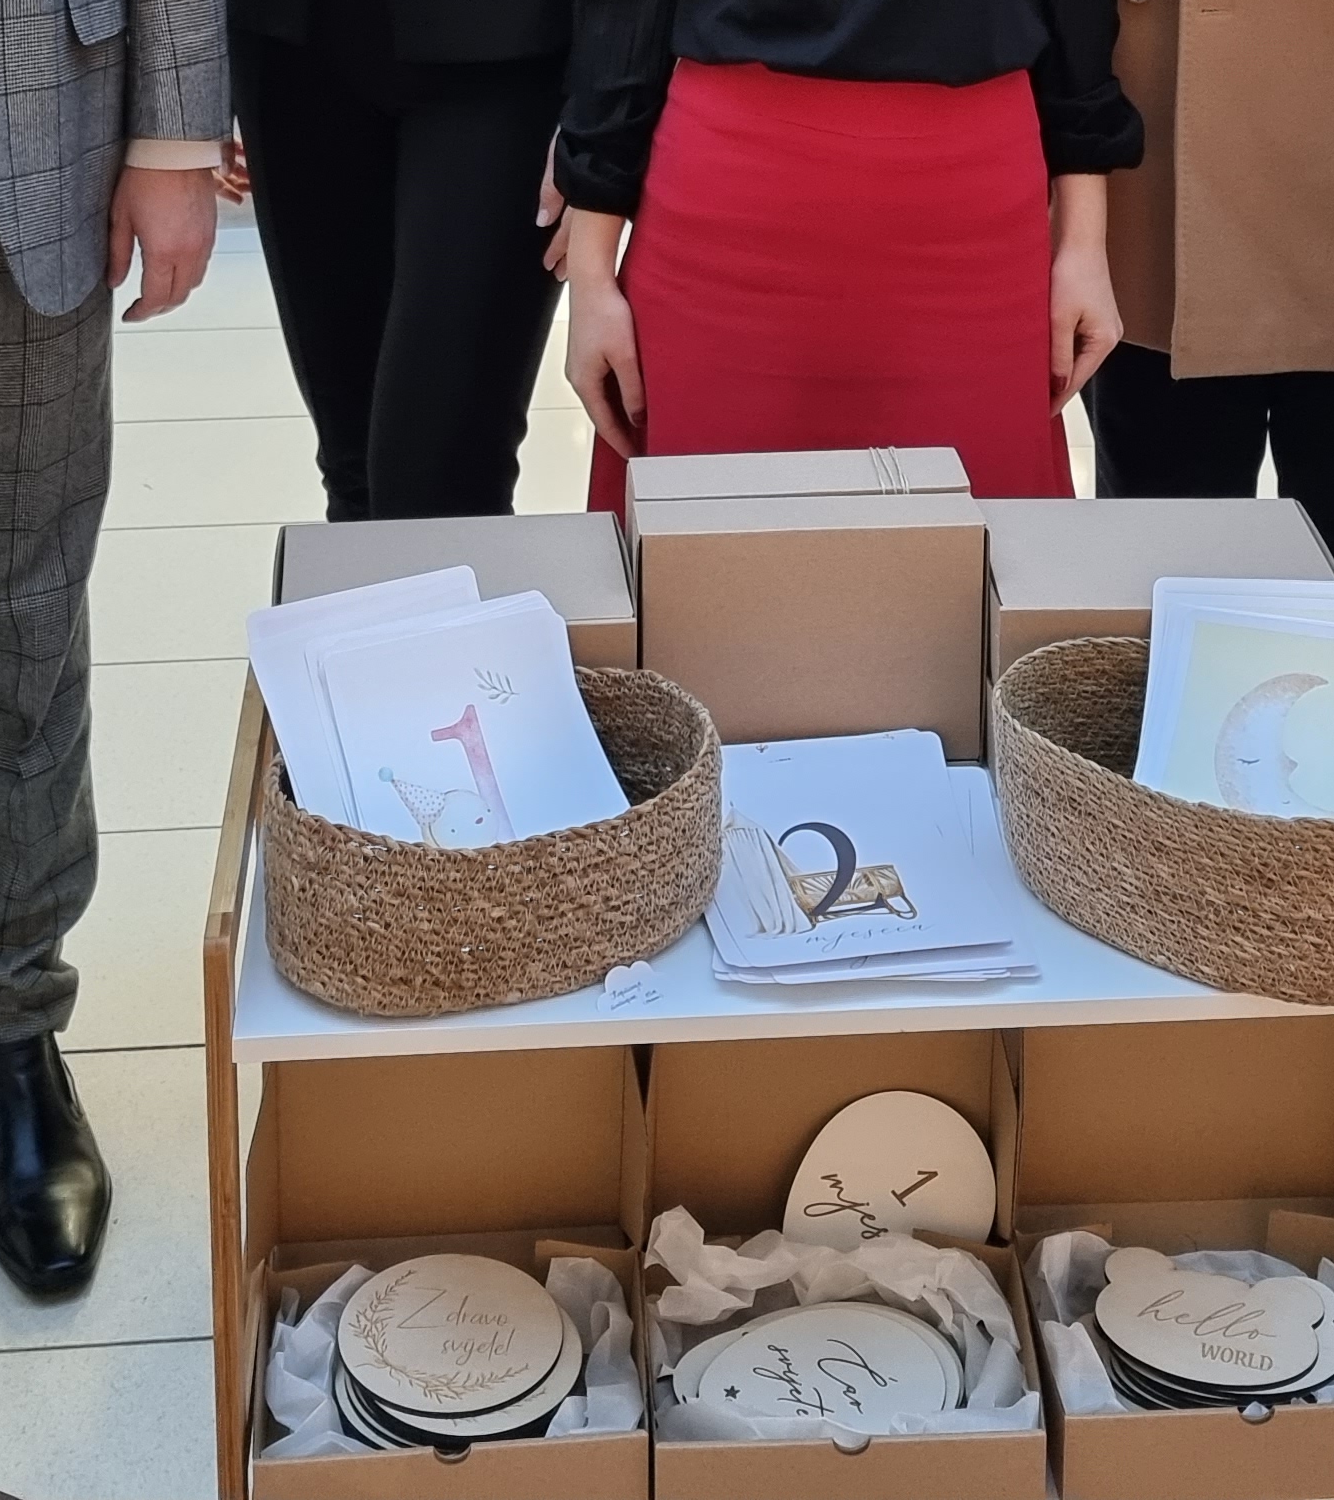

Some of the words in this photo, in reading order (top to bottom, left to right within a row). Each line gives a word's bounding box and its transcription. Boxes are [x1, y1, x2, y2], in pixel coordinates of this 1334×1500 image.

[778, 821, 884, 917] 2
[803, 1173, 889, 1240] mjes
[891, 1170, 939, 1208] 1
[397, 1286, 508, 1330] Zdravo
[1137, 1289, 1277, 1340] hello
[1201, 1342, 1274, 1372] WORLD
